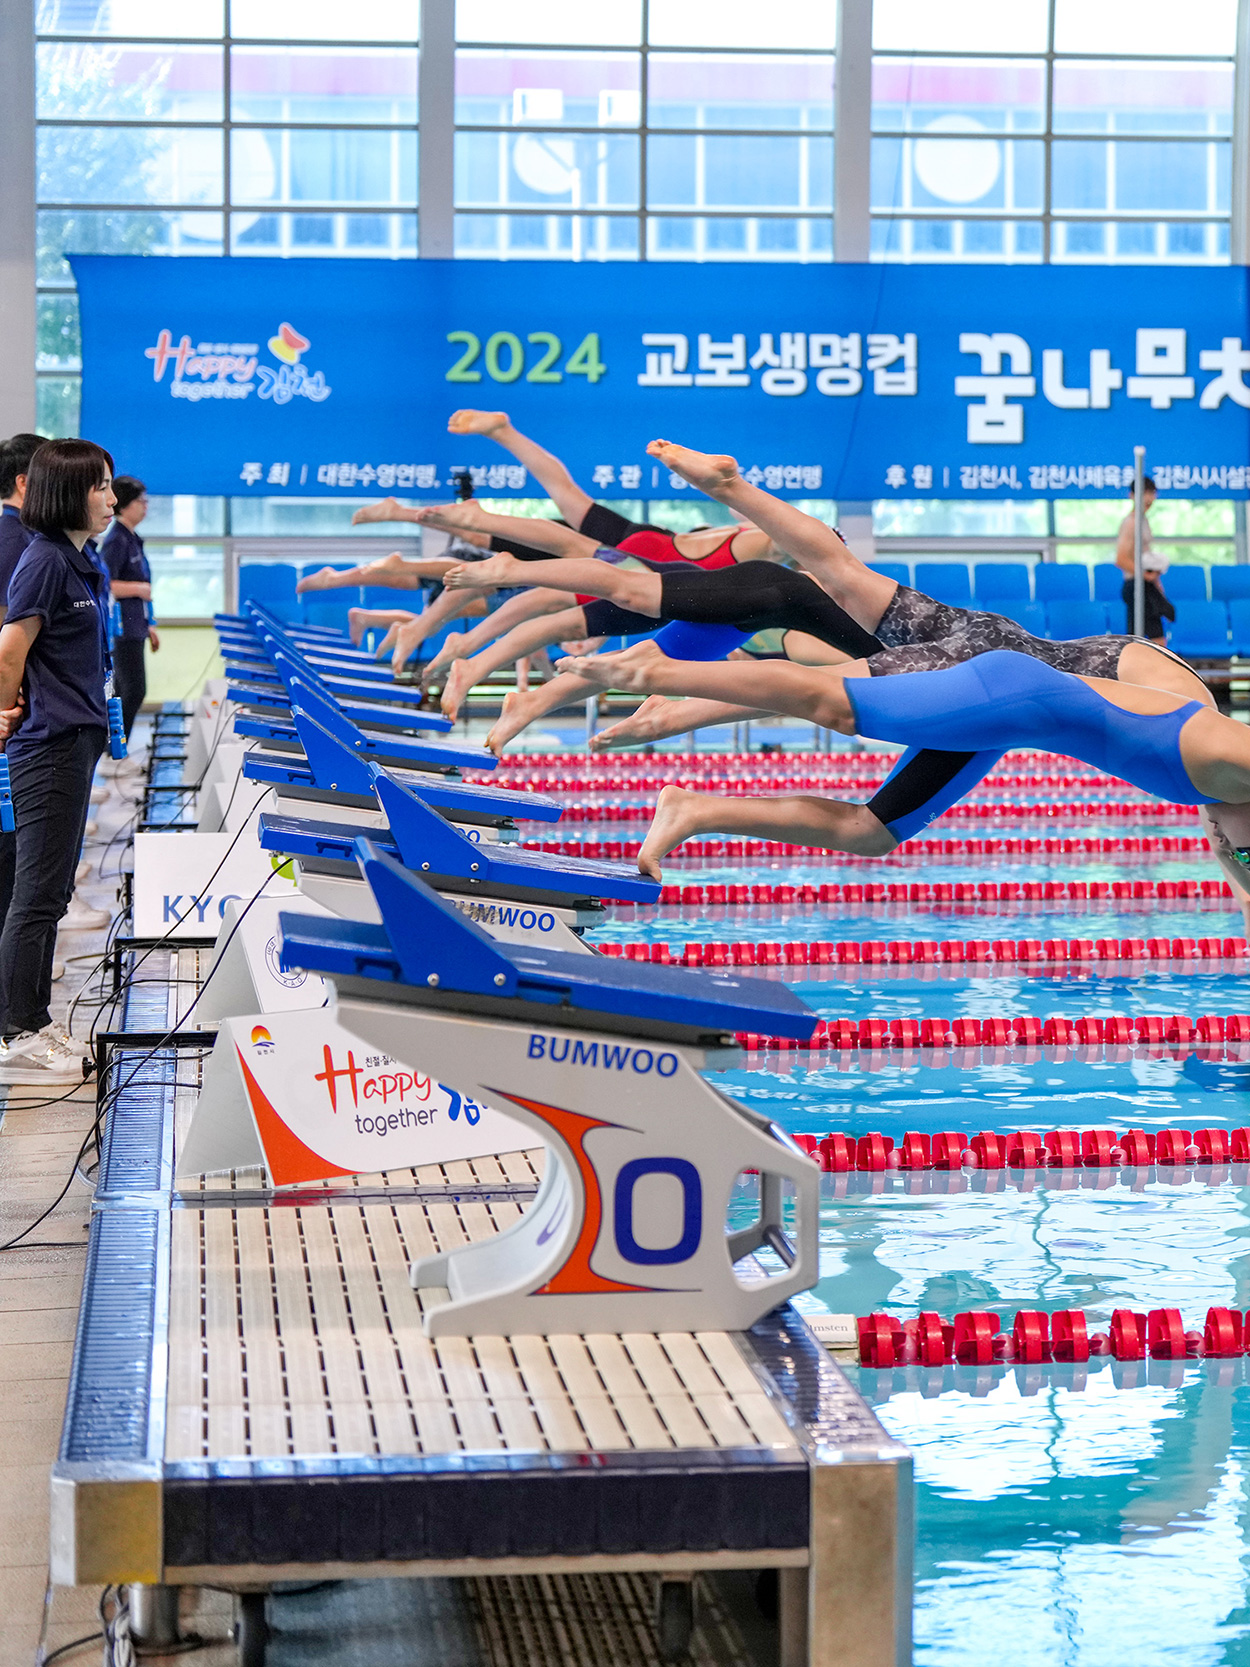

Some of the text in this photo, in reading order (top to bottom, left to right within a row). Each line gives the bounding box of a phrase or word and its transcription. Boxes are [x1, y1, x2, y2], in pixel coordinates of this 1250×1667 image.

[144, 329, 258, 382] Happy
[446, 331, 606, 384] 2024
[637, 332, 918, 396] 교보생명컵
[314, 1044, 432, 1114] Happy
[527, 1033, 679, 1078] BUMWOO
[355, 1108, 438, 1136] together
